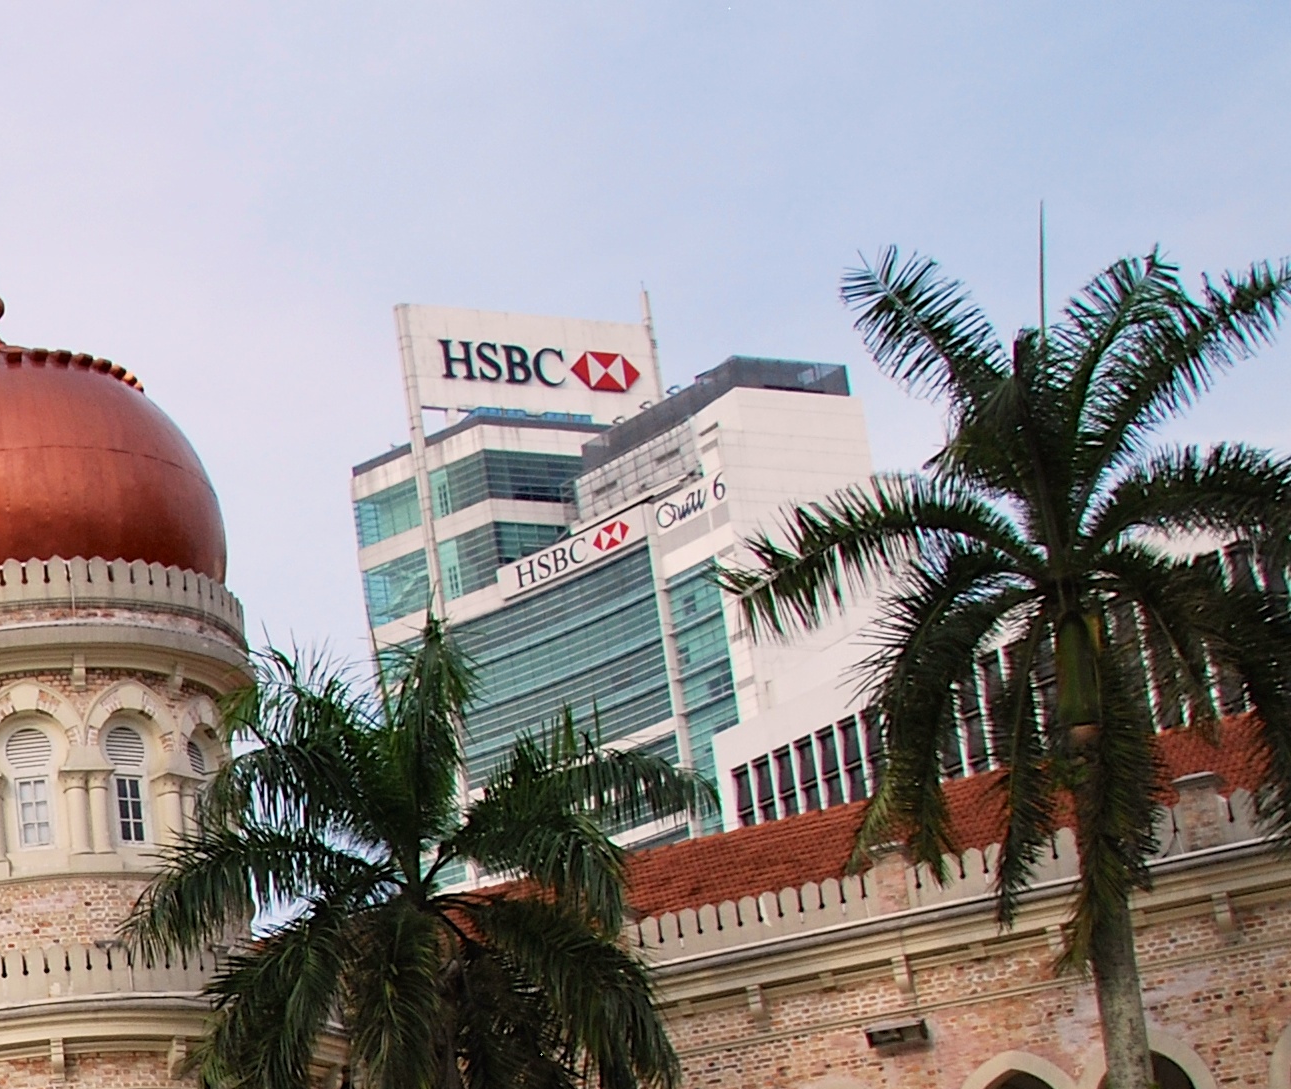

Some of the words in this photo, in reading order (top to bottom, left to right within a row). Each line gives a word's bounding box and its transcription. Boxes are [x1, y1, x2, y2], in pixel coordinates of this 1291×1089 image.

[438, 339, 567, 388] HSBC
[656, 488, 708, 529] Quill
[713, 472, 726, 501] 6
[516, 538, 588, 588] HSBC
